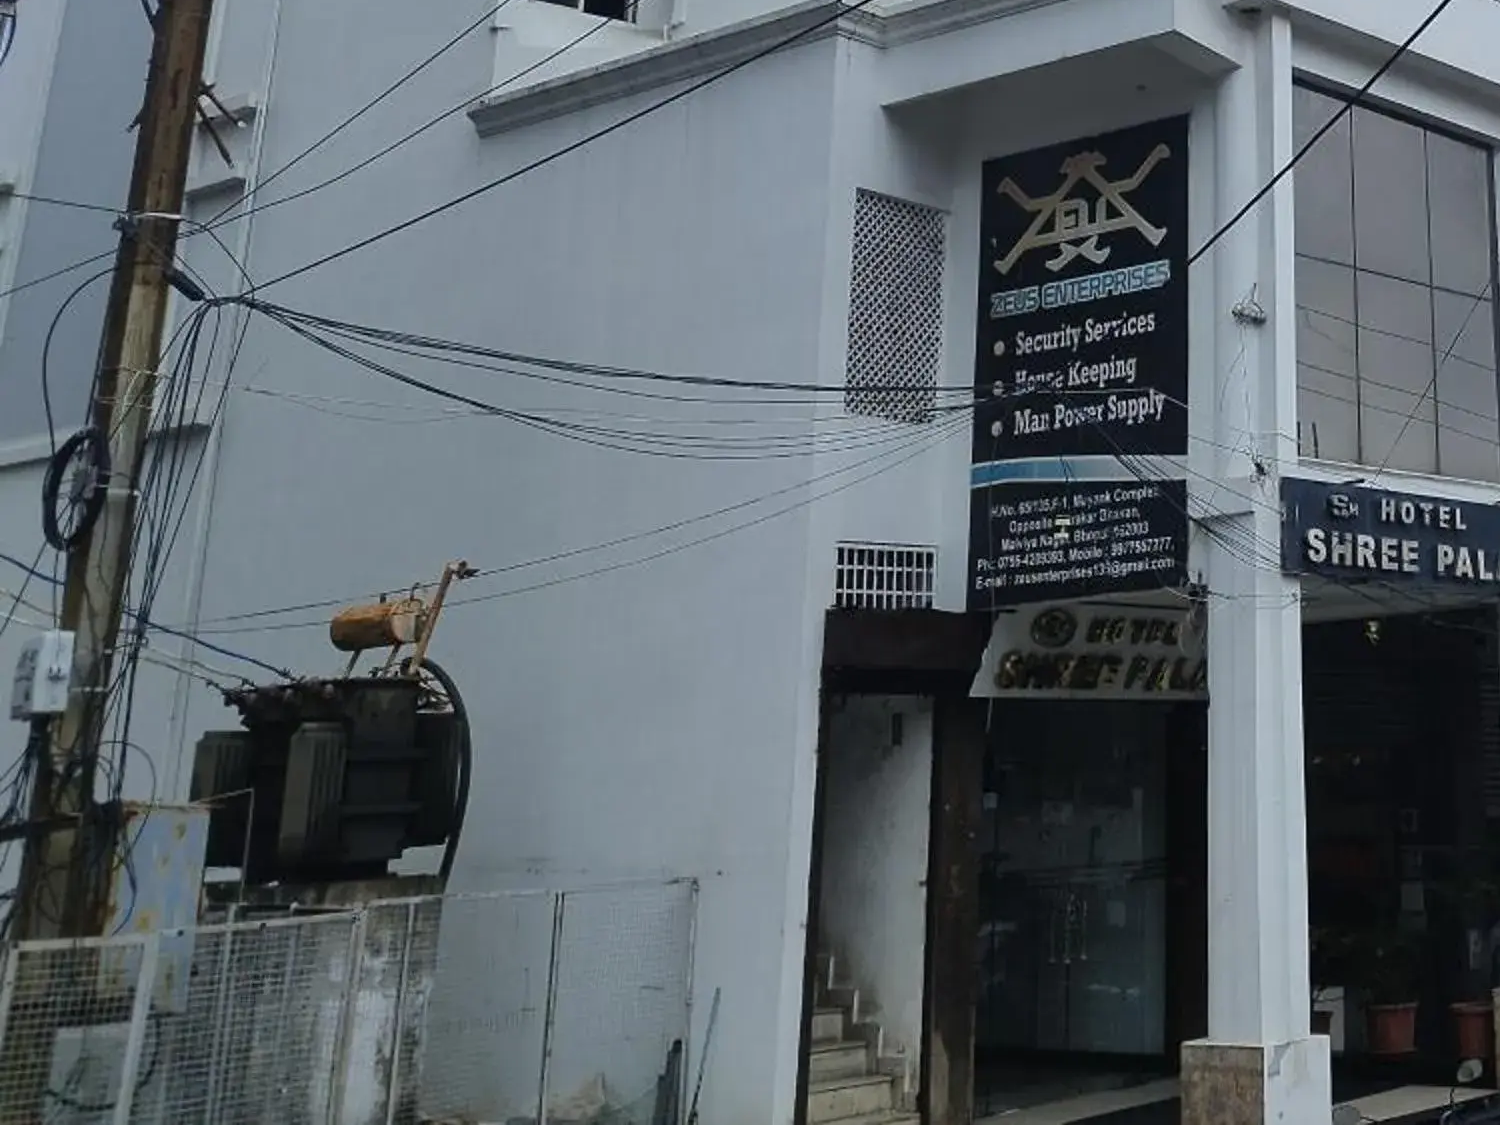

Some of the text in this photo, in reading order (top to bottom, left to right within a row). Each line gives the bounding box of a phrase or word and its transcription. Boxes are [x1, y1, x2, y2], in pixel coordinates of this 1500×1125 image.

[990, 259, 1170, 317] ZEUS ENTERPRISES
[1014, 311, 1156, 355] Security Services
[1067, 355, 1138, 387] Keeping
[1013, 392, 1166, 436] Man Power Supply
[1380, 497, 1467, 531] HOTEL
[1306, 527, 1421, 573] SHREE
